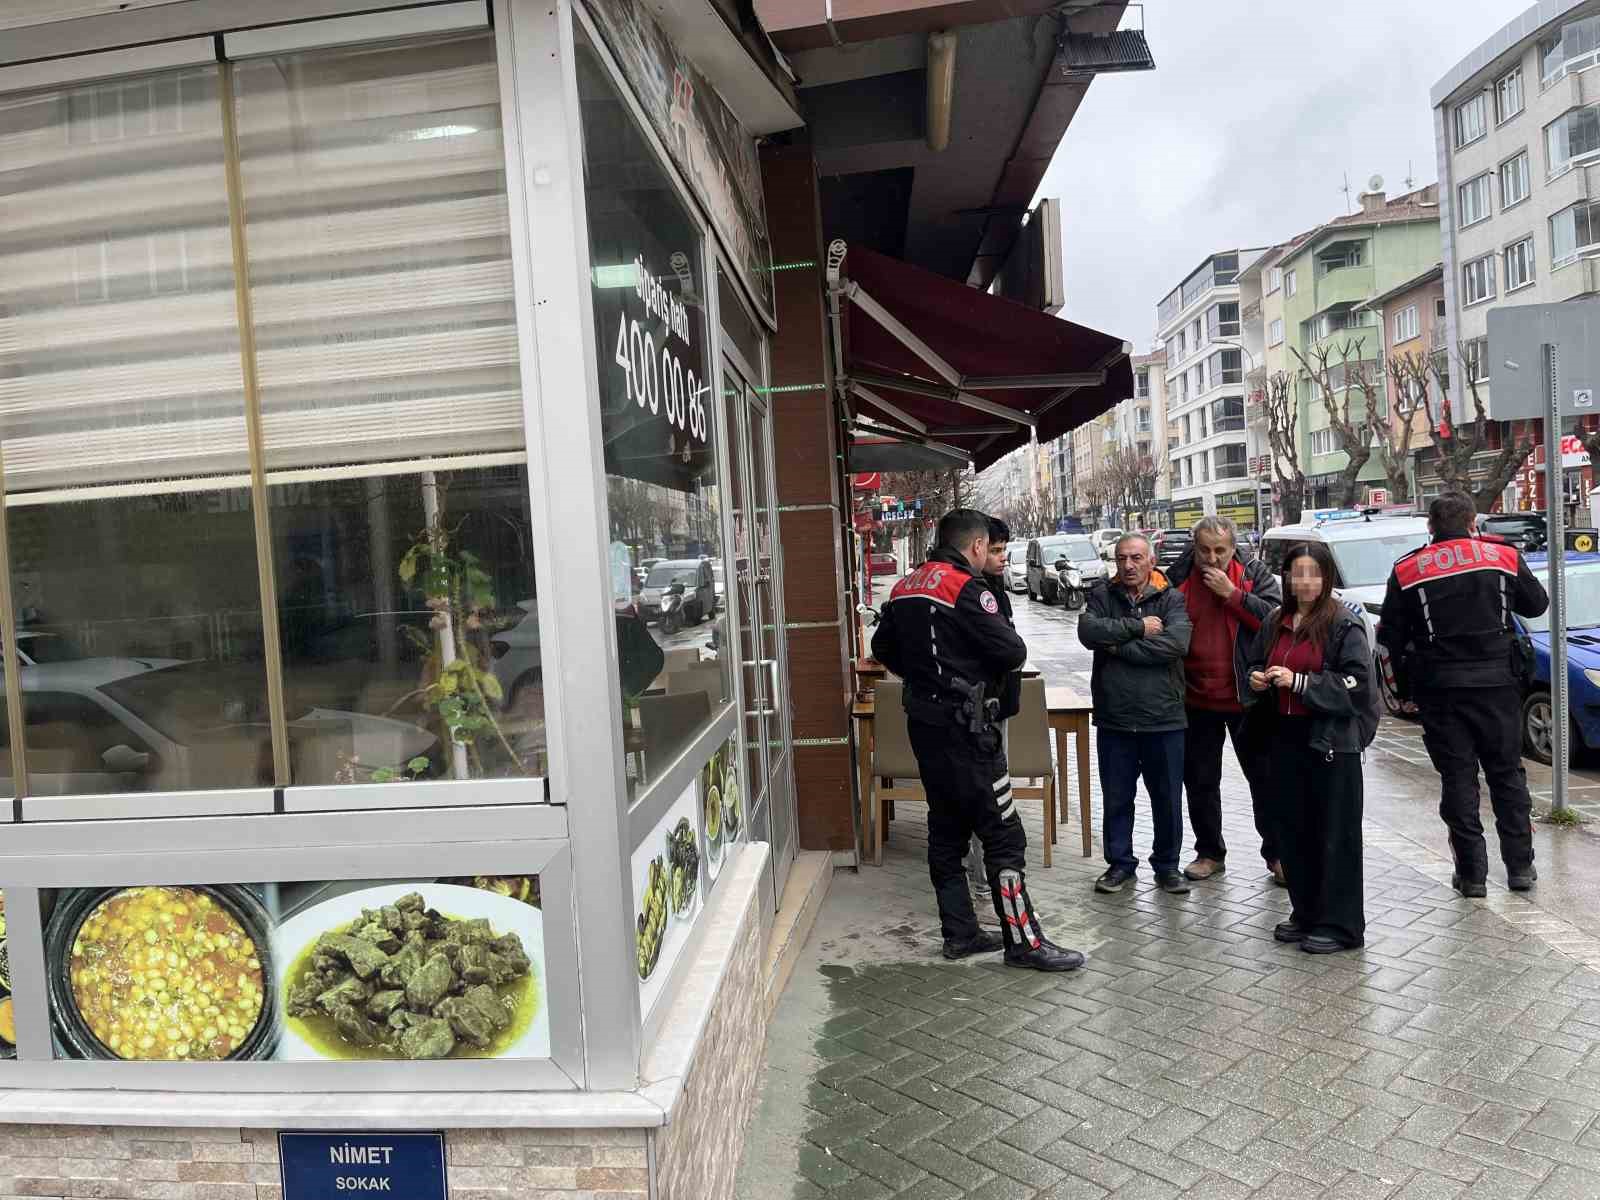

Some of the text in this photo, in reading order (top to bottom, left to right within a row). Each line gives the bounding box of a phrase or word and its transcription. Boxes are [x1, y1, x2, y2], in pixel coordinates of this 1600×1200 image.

[616, 311, 659, 416] 400
[662, 347, 685, 431] 00
[330, 1142, 393, 1165] NİMET
[336, 1176, 392, 1191] SOKAK
